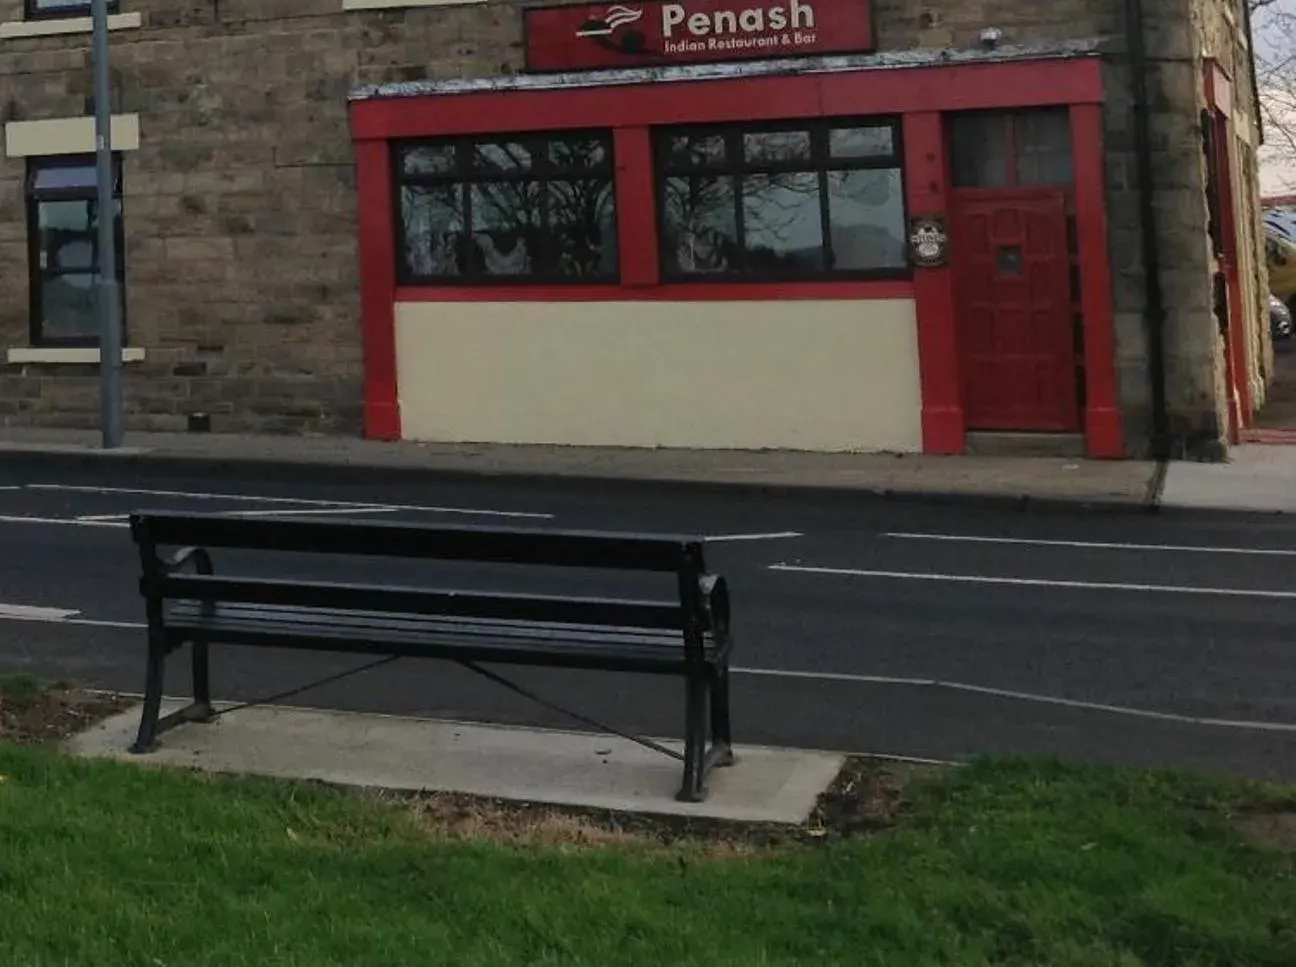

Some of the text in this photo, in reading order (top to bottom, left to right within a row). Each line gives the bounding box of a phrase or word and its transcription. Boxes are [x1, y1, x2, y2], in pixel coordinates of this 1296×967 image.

[665, 32, 817, 54] Indian Restaurant & Bar
